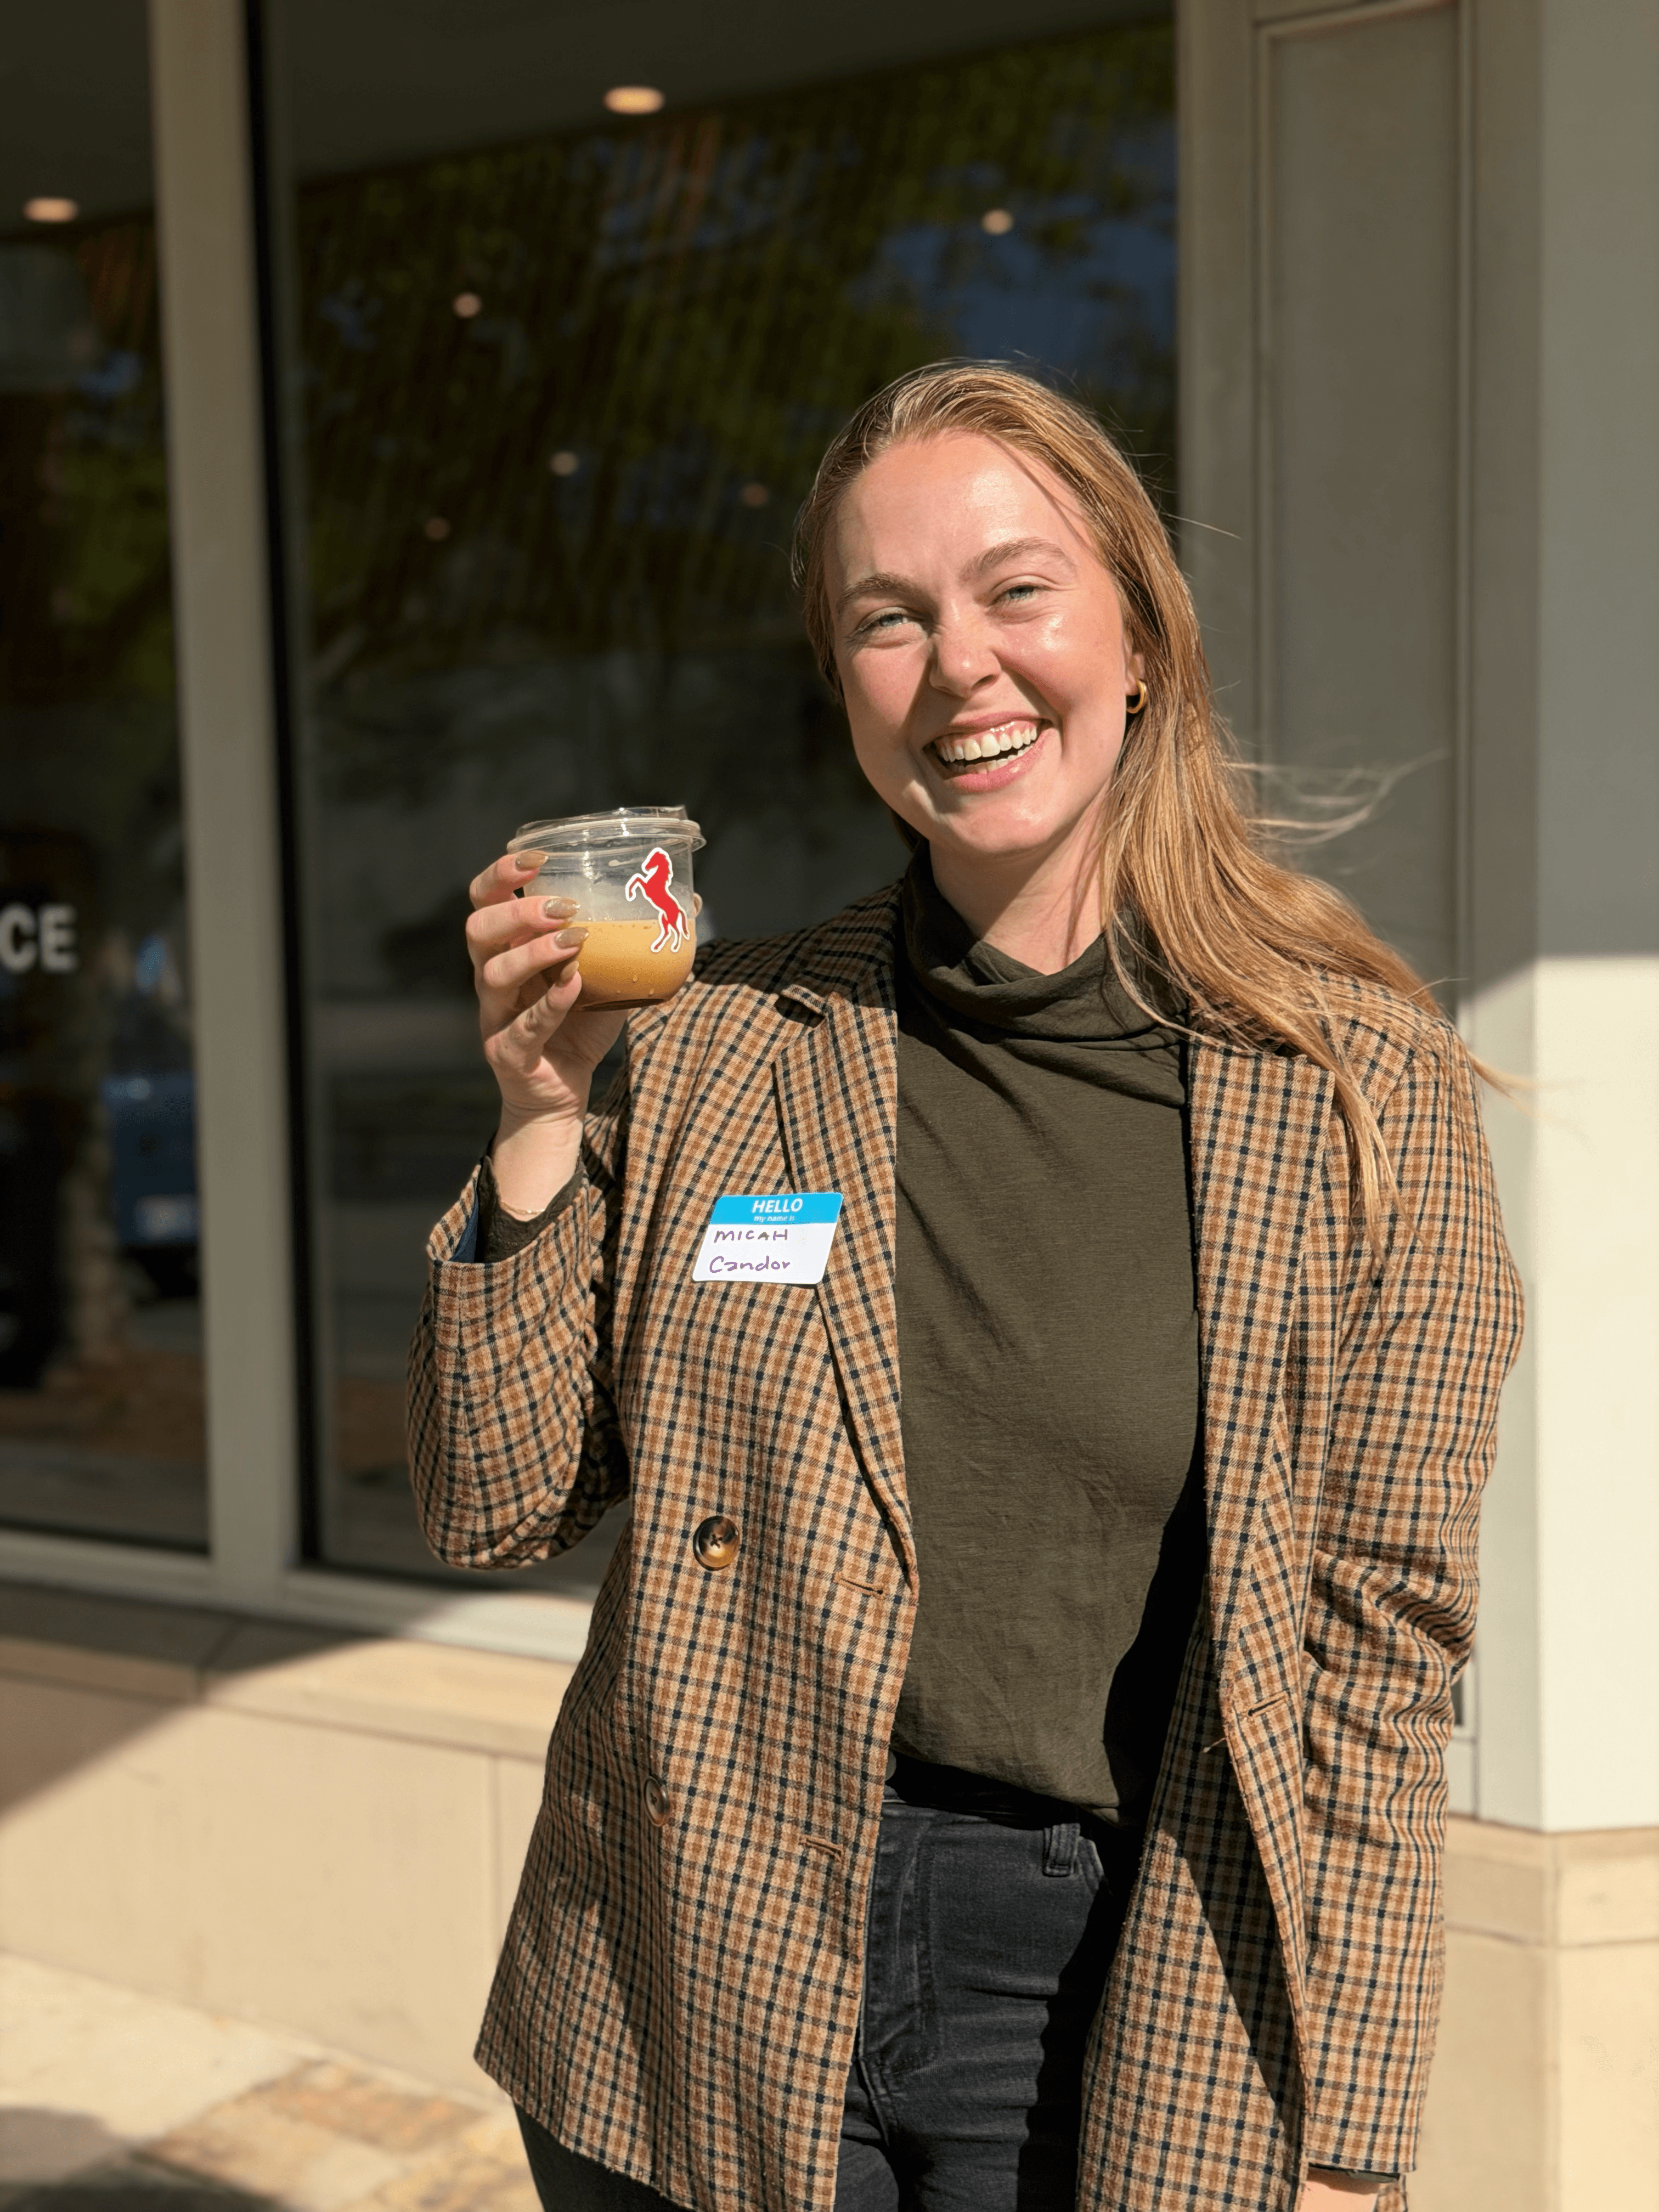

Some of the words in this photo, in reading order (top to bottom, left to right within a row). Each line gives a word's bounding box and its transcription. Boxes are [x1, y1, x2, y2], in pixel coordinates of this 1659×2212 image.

[752, 1198, 803, 1213] HELLO
[714, 1229, 788, 1243] MICAH
[709, 1255, 791, 1273] Candor
